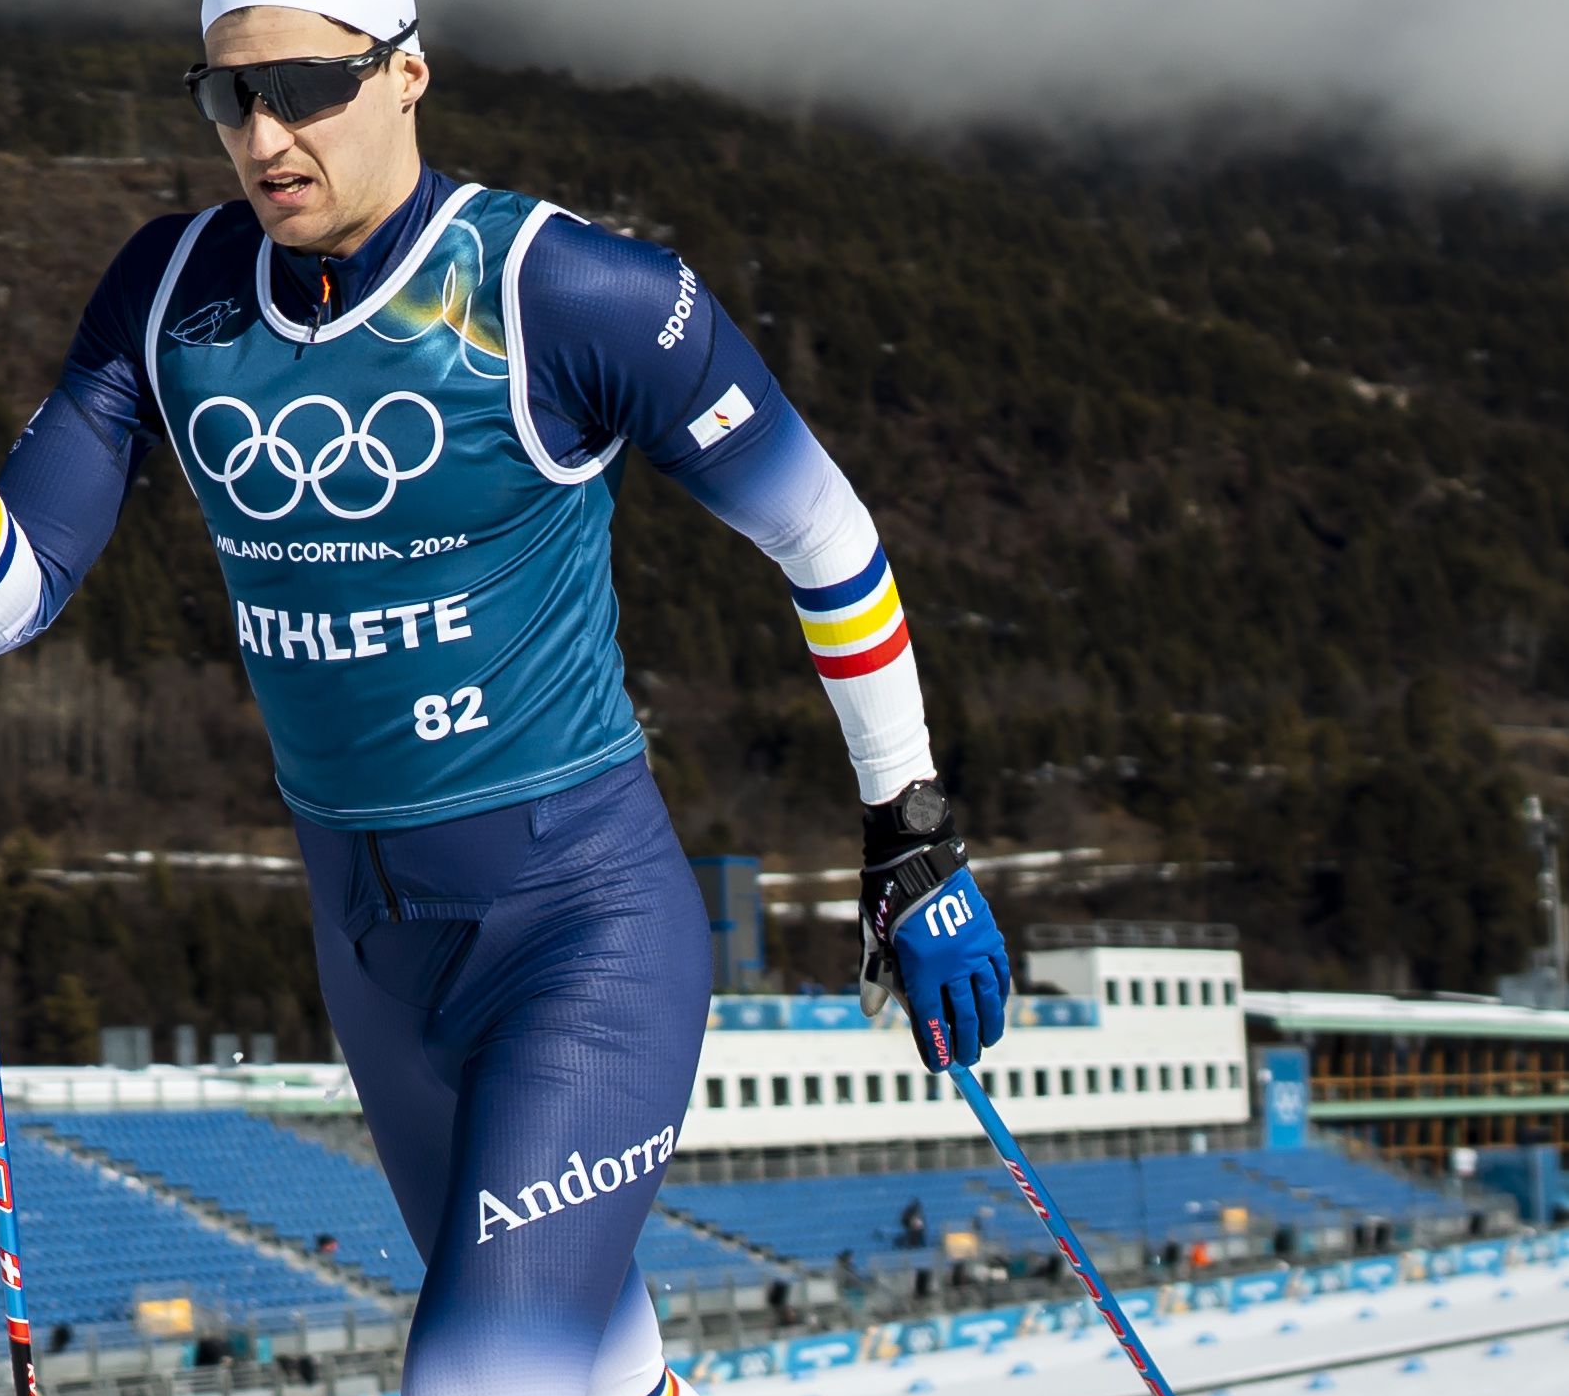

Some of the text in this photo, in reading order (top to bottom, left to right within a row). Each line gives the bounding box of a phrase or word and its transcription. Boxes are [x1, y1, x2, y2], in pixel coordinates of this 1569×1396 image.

[216, 534, 469, 562] MILANO CORTINA 2026
[236, 592, 472, 661] ATHLETE
[413, 686, 489, 741] 82
[476, 1124, 675, 1245] Andorra
